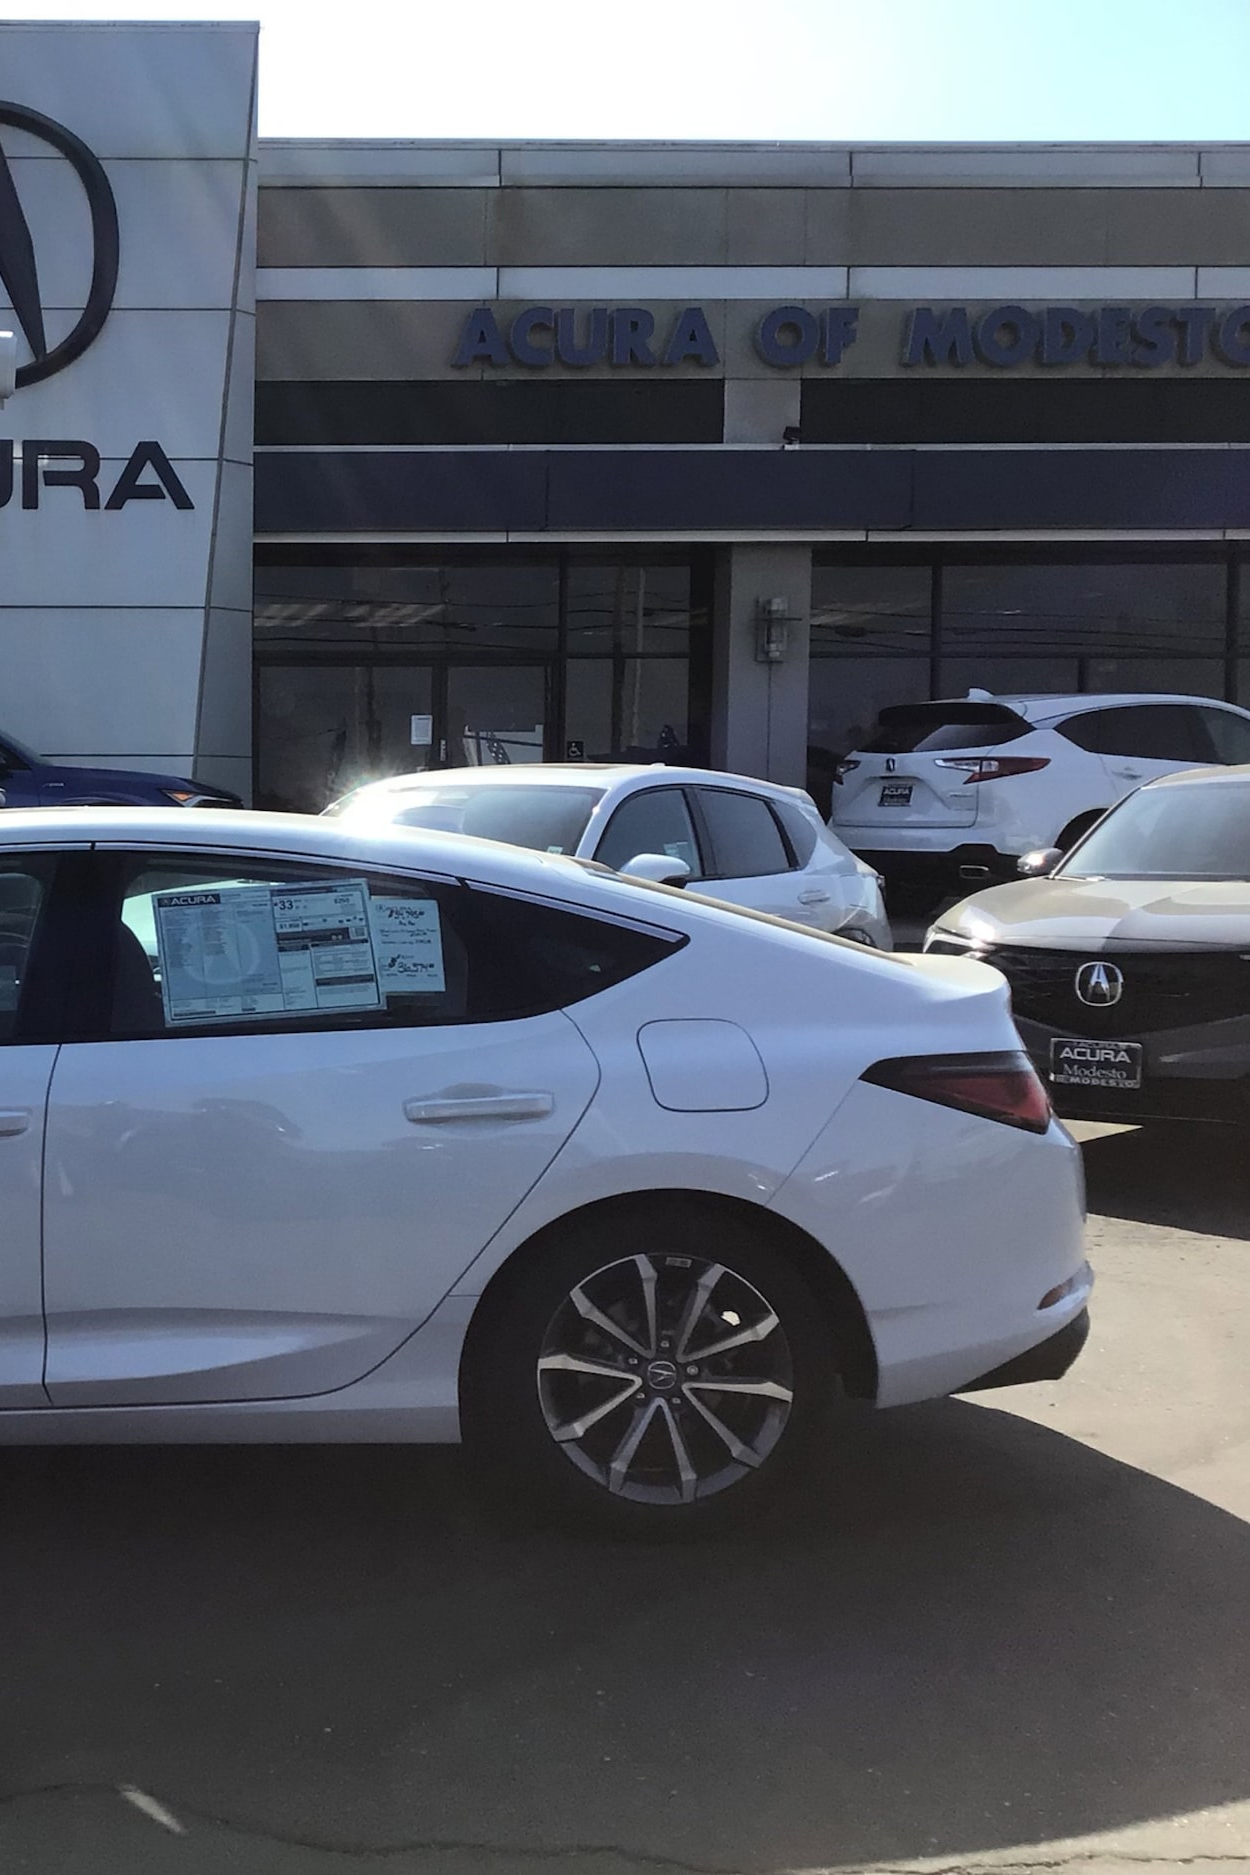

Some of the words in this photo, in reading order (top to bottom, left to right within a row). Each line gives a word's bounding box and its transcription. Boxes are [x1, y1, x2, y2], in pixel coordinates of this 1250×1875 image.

[450, 306, 719, 368] ACURA
[758, 305, 859, 368] OF
[171, 895, 216, 906] ACURA
[279, 900, 294, 911] 33
[1059, 1047, 1131, 1062] ACURA
[1063, 1064, 1127, 1079] Modesto
